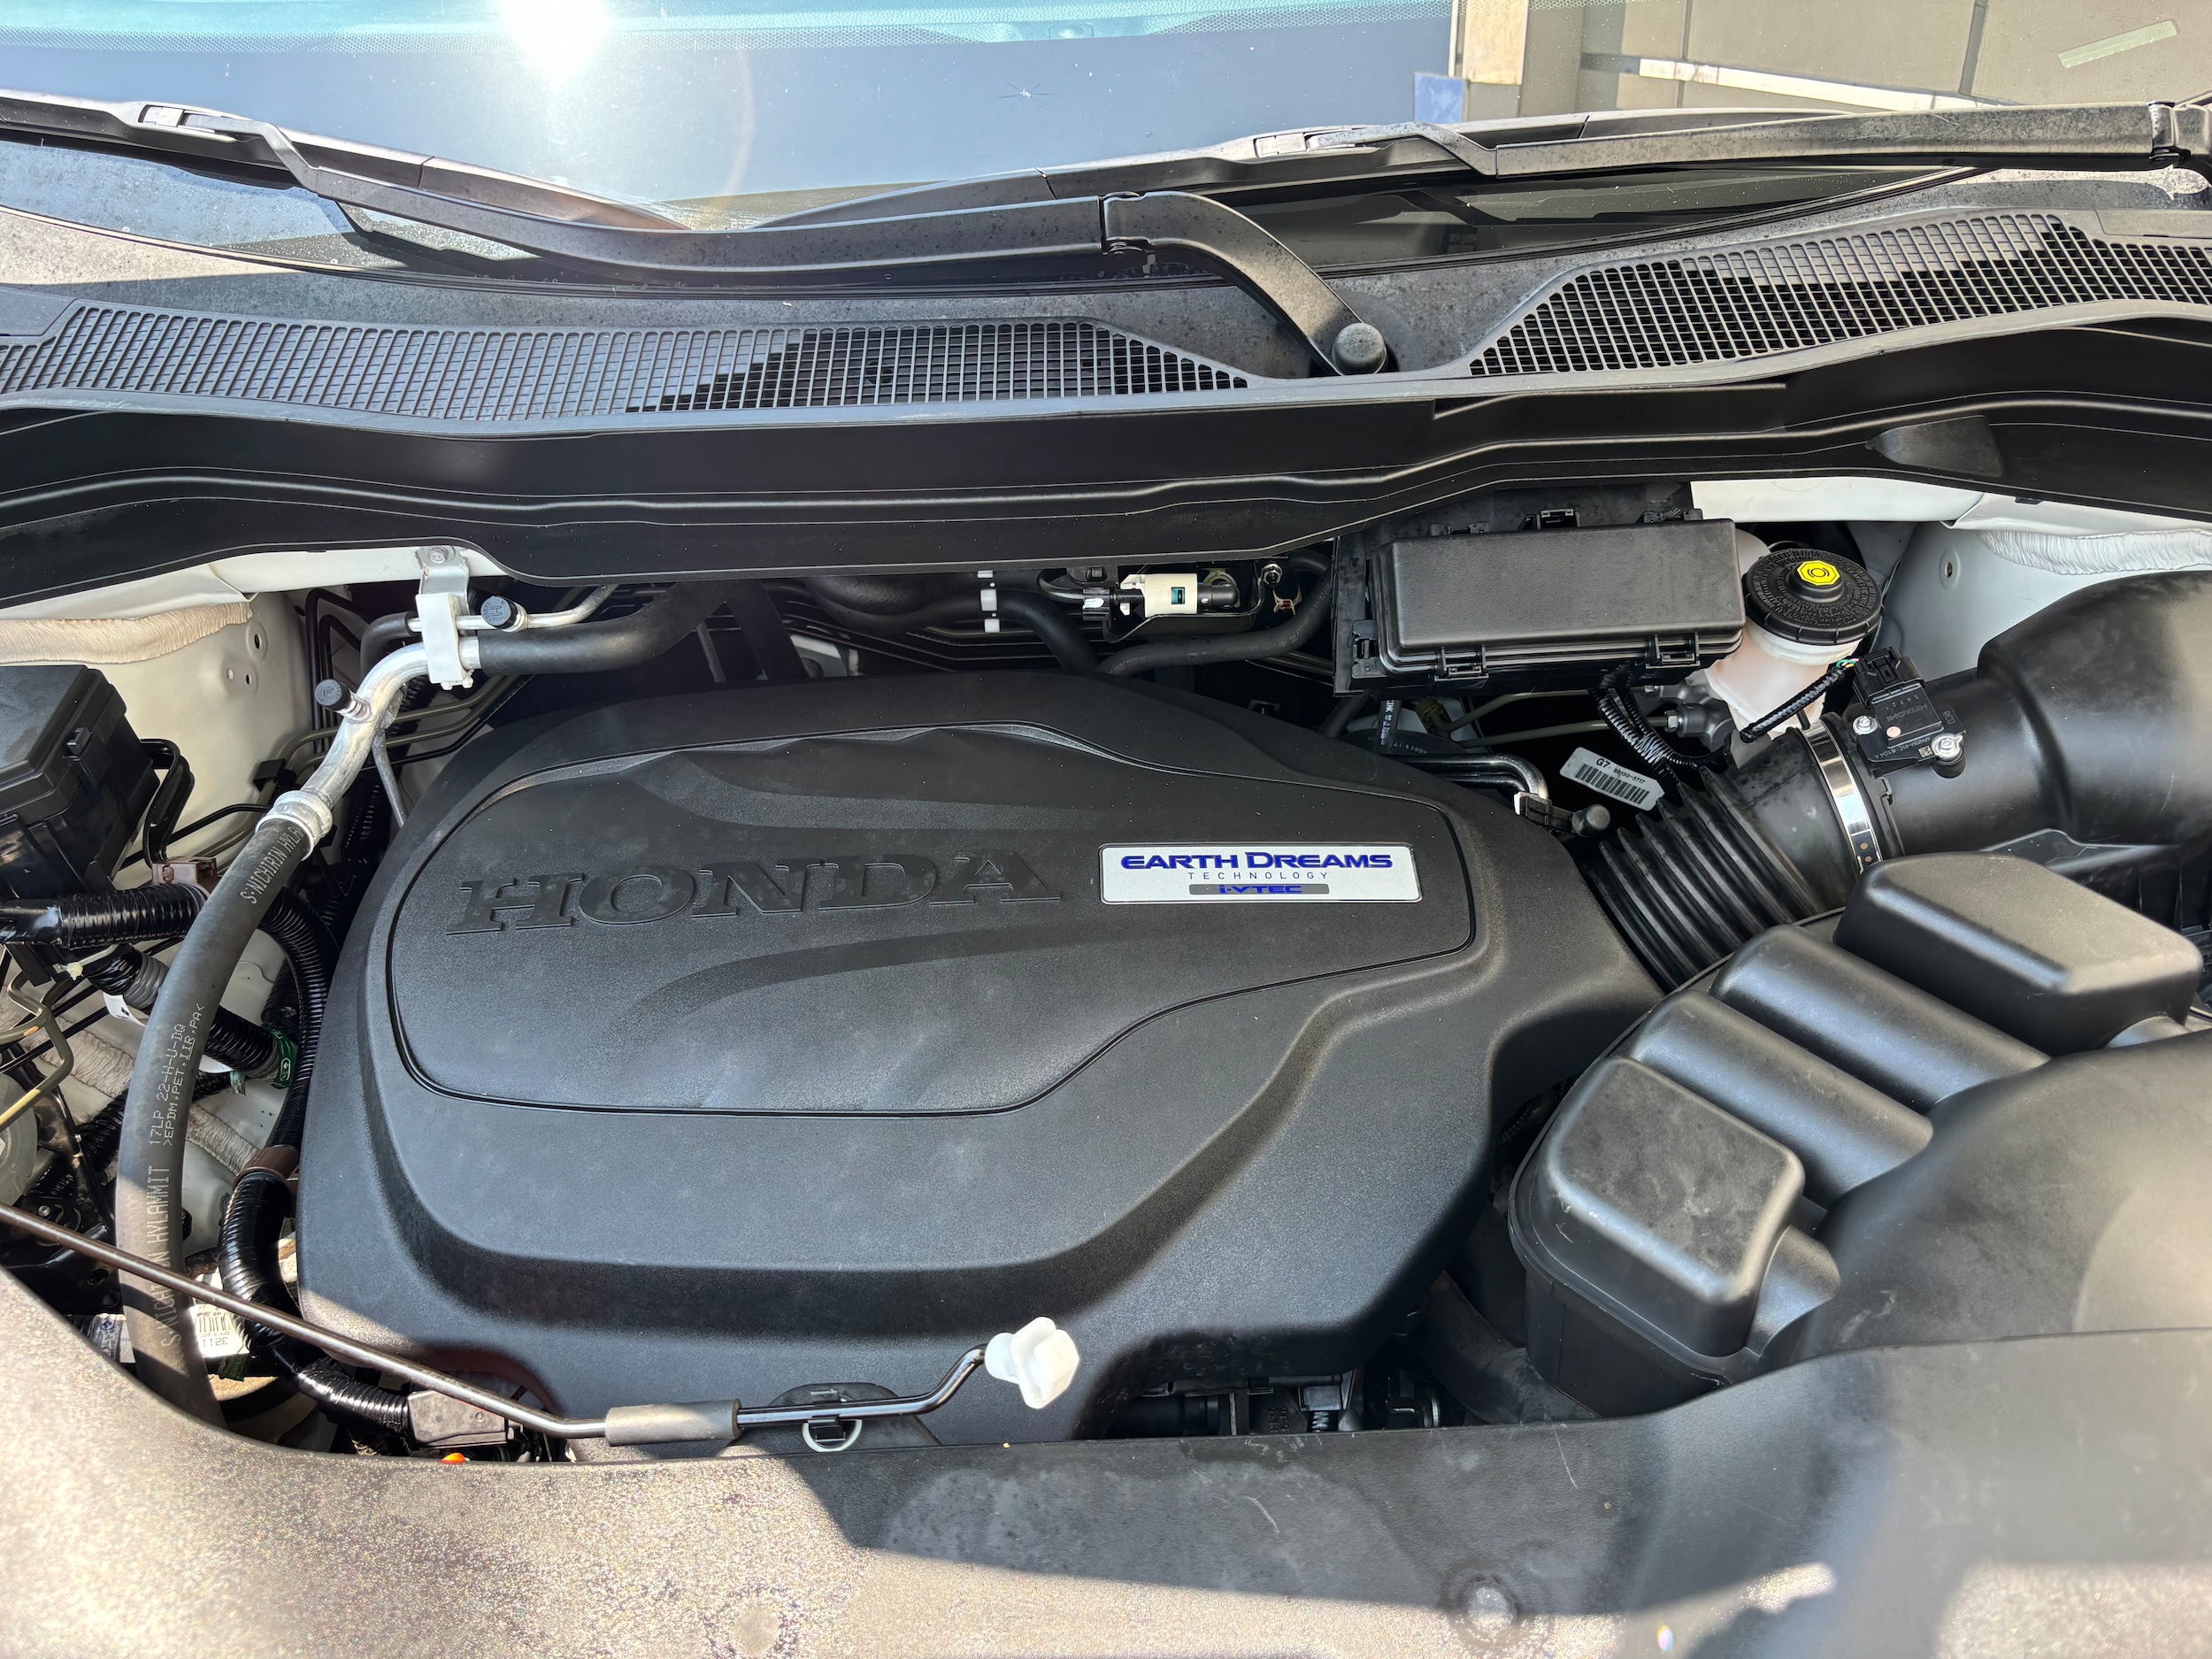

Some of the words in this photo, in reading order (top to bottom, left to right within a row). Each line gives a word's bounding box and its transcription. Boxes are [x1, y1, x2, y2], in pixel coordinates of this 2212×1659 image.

[1596, 758, 1611, 768] G7
[1120, 854, 1239, 870] EARTH
[1244, 851, 1394, 869] DREAMS
[1187, 872, 1328, 880] TECHNOLOGY
[445, 851, 1061, 936] HONDA
[1219, 884, 1302, 894] i-VTEC
